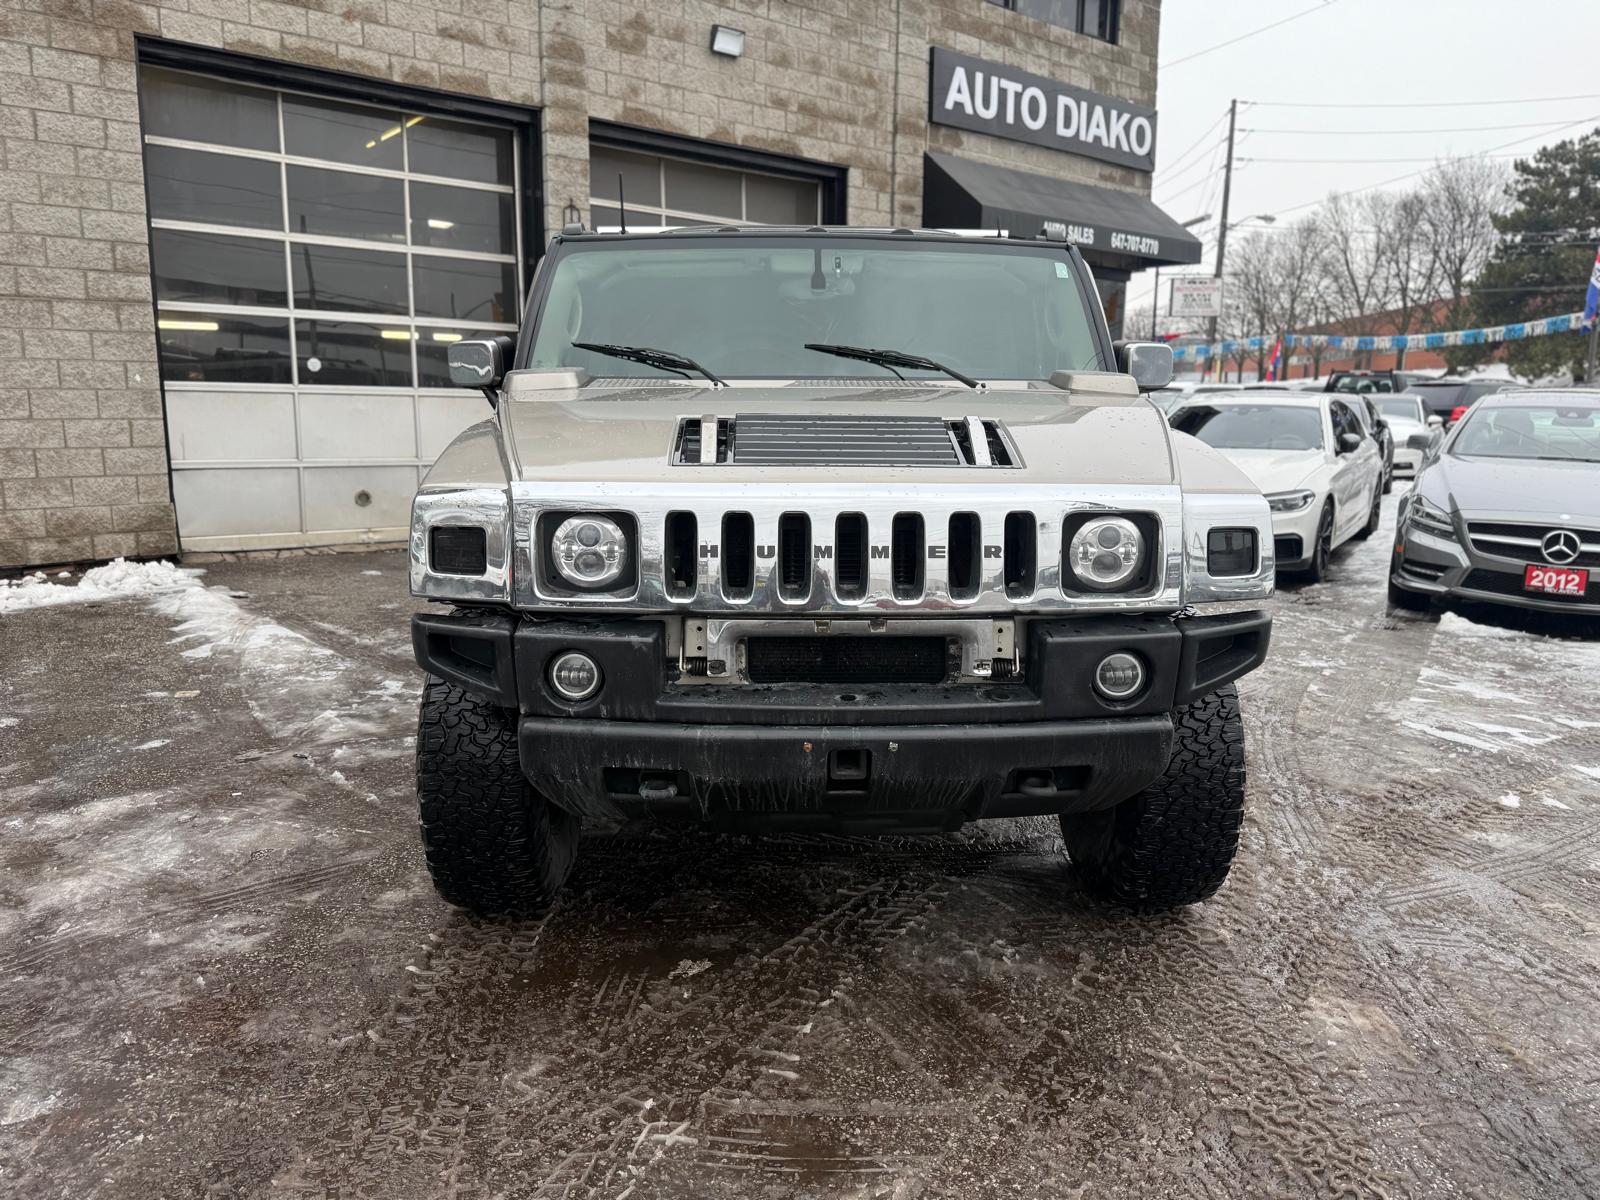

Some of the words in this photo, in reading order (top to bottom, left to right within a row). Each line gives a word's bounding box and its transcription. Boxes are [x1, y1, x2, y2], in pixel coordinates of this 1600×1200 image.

[944, 66, 1047, 130] AUTO
[1056, 94, 1152, 156] DIAKO
[1067, 225, 1095, 245] SALES
[699, 545, 1003, 559] HUMMER
[1530, 570, 1580, 590] 2012
